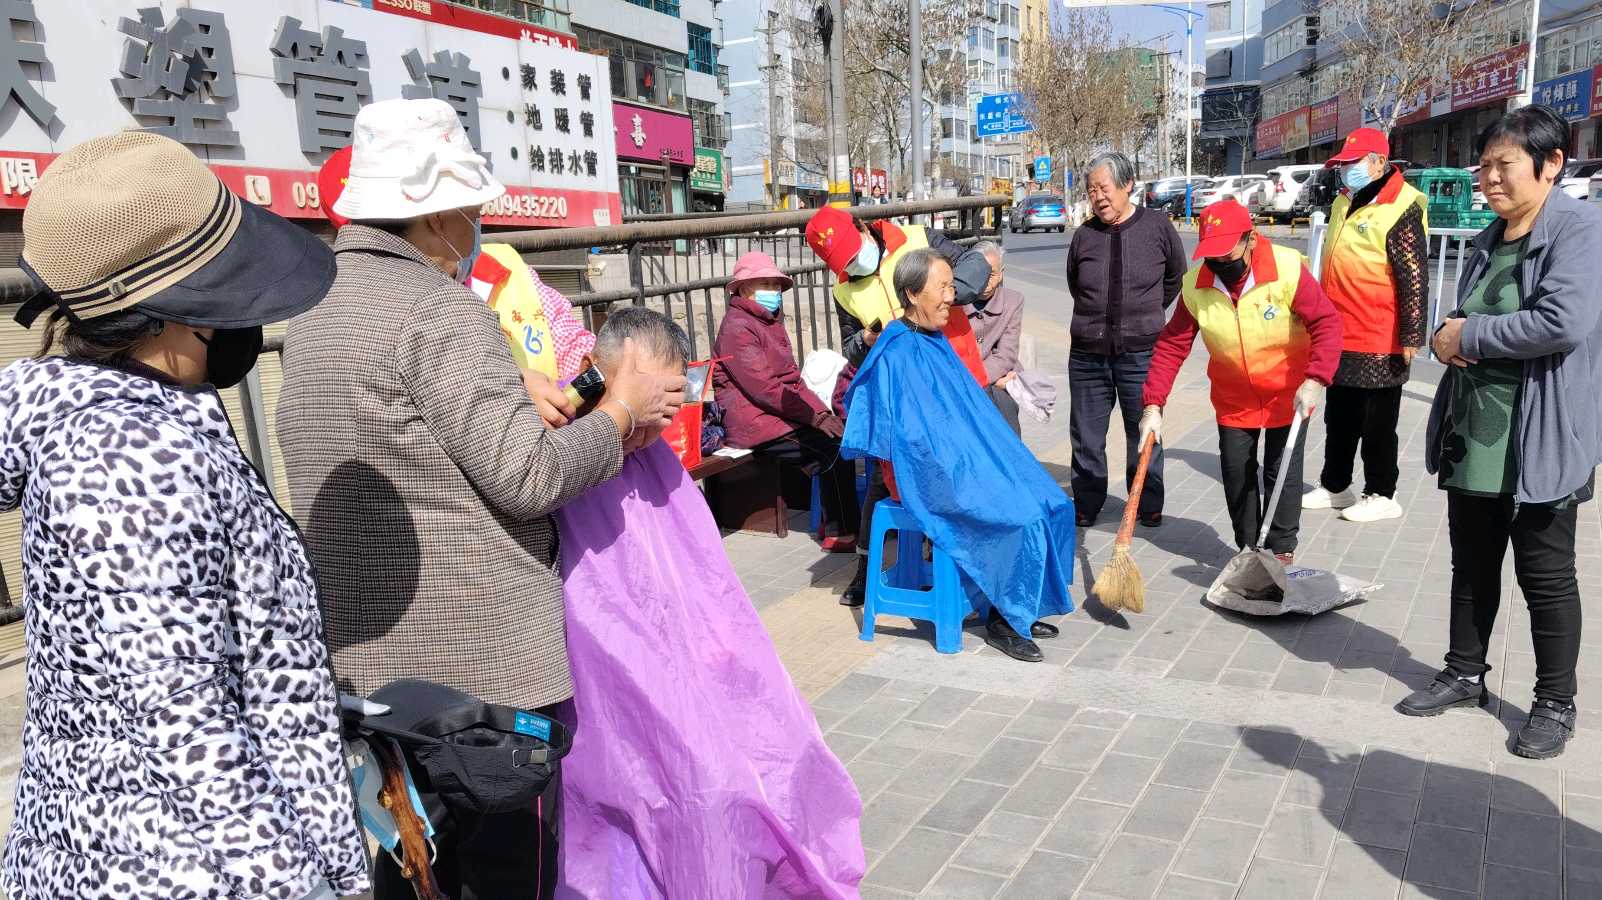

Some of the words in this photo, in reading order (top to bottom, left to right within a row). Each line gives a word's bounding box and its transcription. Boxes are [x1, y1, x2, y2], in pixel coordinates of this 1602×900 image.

[520, 63, 592, 102] 家装管
[523, 102, 595, 138] 地暖管
[528, 144, 598, 178] 给排水管
